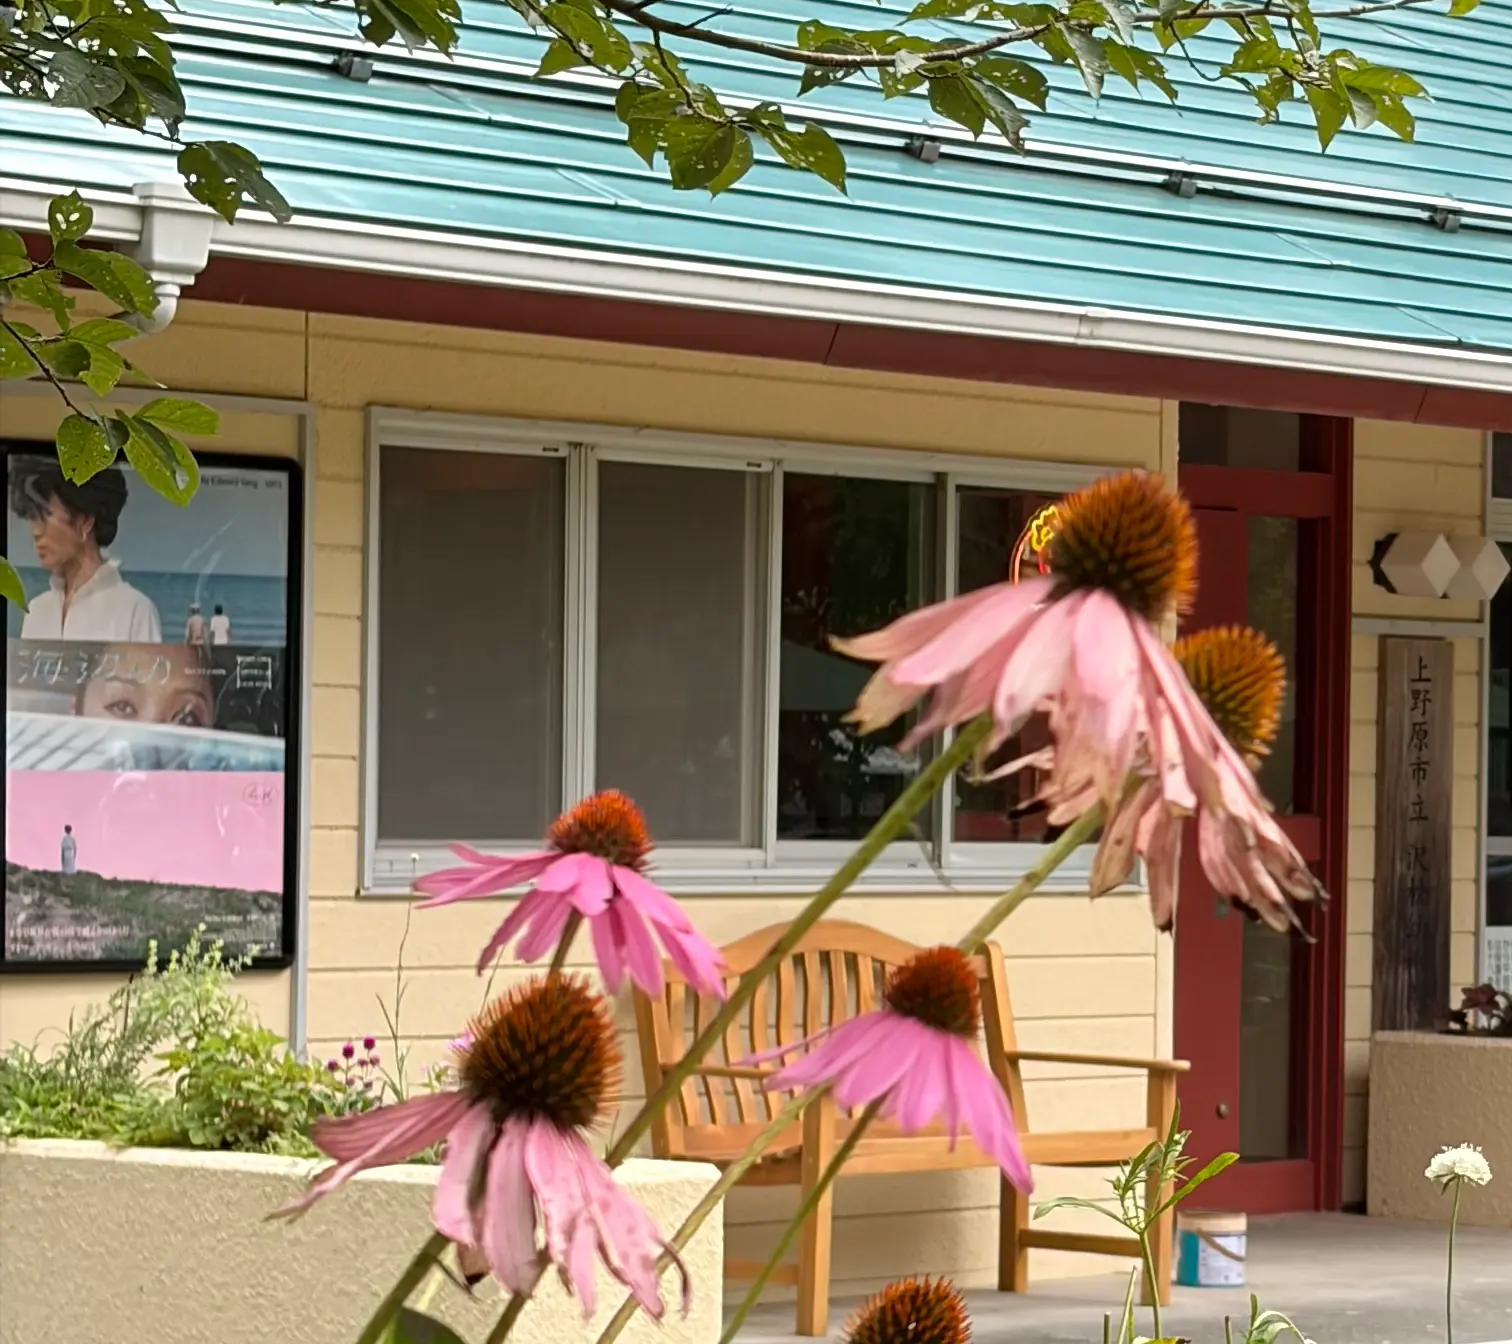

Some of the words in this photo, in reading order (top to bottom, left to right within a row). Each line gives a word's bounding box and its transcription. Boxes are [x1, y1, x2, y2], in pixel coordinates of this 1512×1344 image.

[1408, 653, 1432, 824] 上野原市立
